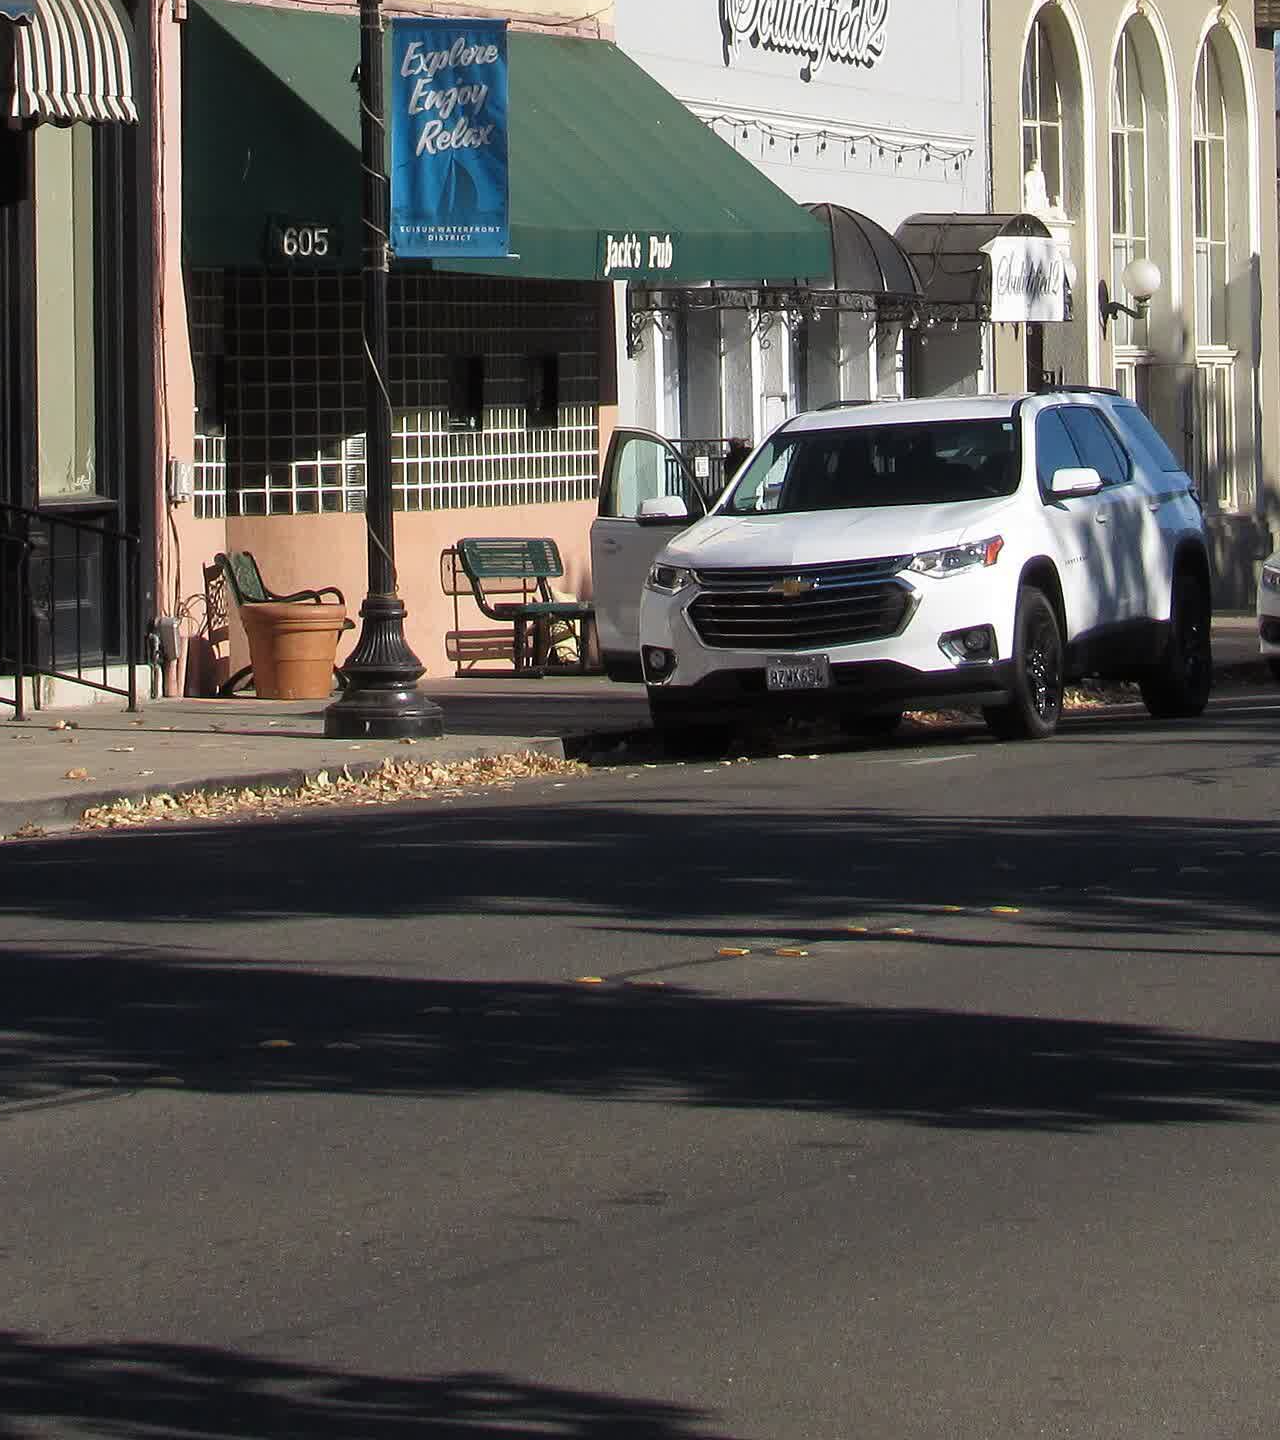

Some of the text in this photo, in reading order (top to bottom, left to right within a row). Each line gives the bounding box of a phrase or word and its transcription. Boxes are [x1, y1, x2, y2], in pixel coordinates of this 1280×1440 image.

[401, 37, 499, 77] Explore
[408, 78, 488, 119] Enjoy
[416, 119, 495, 157] Relax
[283, 228, 329, 255] 605
[400, 225, 500, 233] SUISUN WATERFRONT
[603, 233, 674, 277] Jack's Pub
